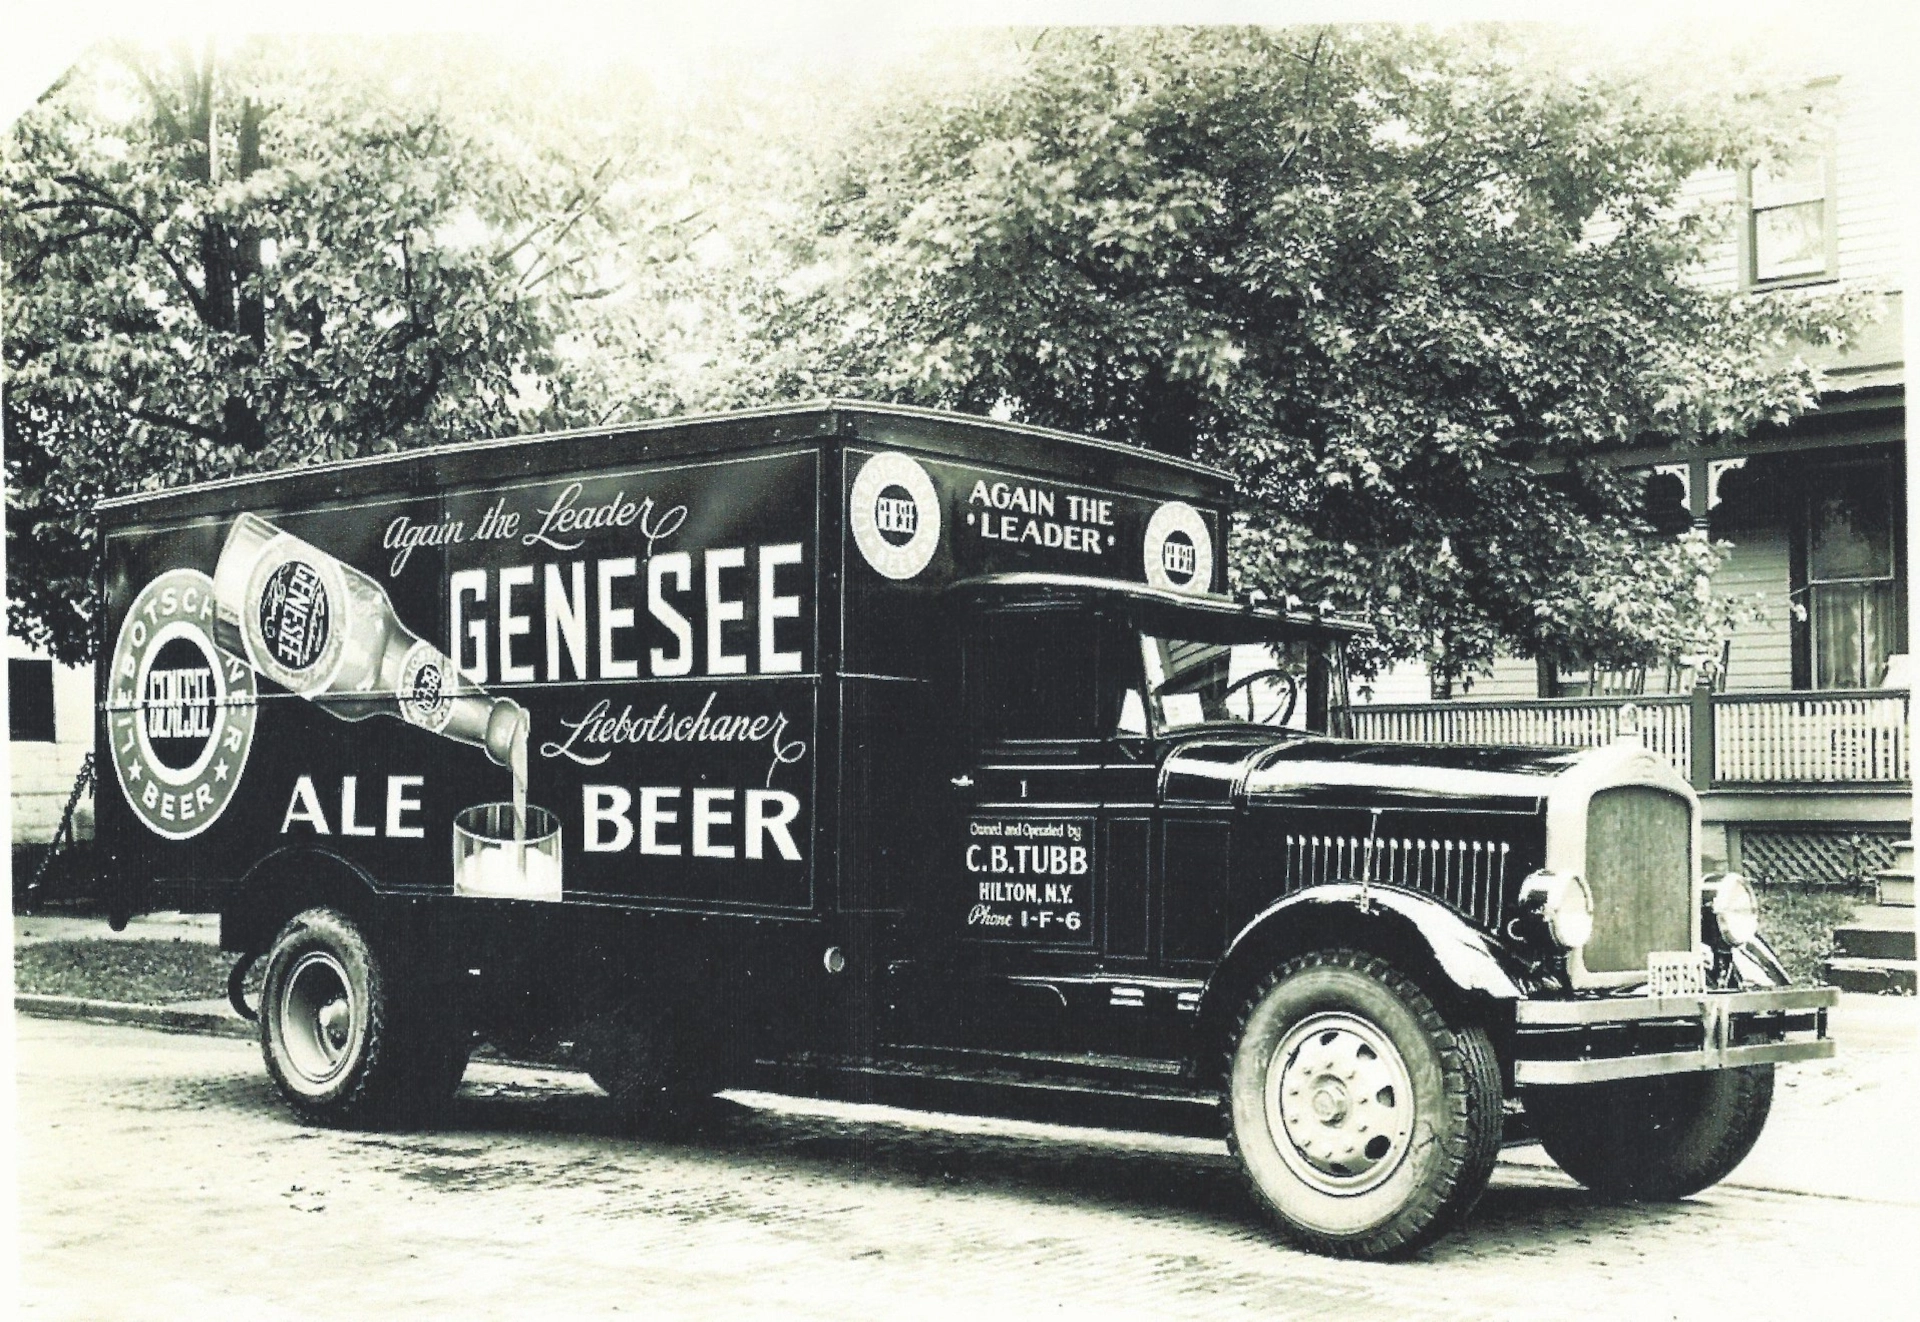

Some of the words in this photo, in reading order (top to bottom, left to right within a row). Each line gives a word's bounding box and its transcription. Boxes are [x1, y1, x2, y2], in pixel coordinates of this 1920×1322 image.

[968, 480, 1055, 517] AGAIN
[1066, 495, 1114, 526] THE
[383, 512, 463, 577] Again
[470, 497, 520, 541] the
[522, 482, 688, 556] Leader
[981, 513, 1102, 555] LEADER
[450, 541, 804, 684] GENESEE
[540, 692, 806, 788] Liebotschaner
[141, 780, 215, 821] BEER
[280, 774, 425, 839] ALE
[582, 784, 803, 861] BEER
[969, 822, 1003, 836] Owned
[1004, 822, 1022, 836] and
[1022, 823, 1064, 840] Operated
[1067, 823, 1082, 841] by
[967, 903, 1014, 927] Phone
[979, 881, 1043, 905] HILTON,
[1044, 883, 1074, 904] N.Y.
